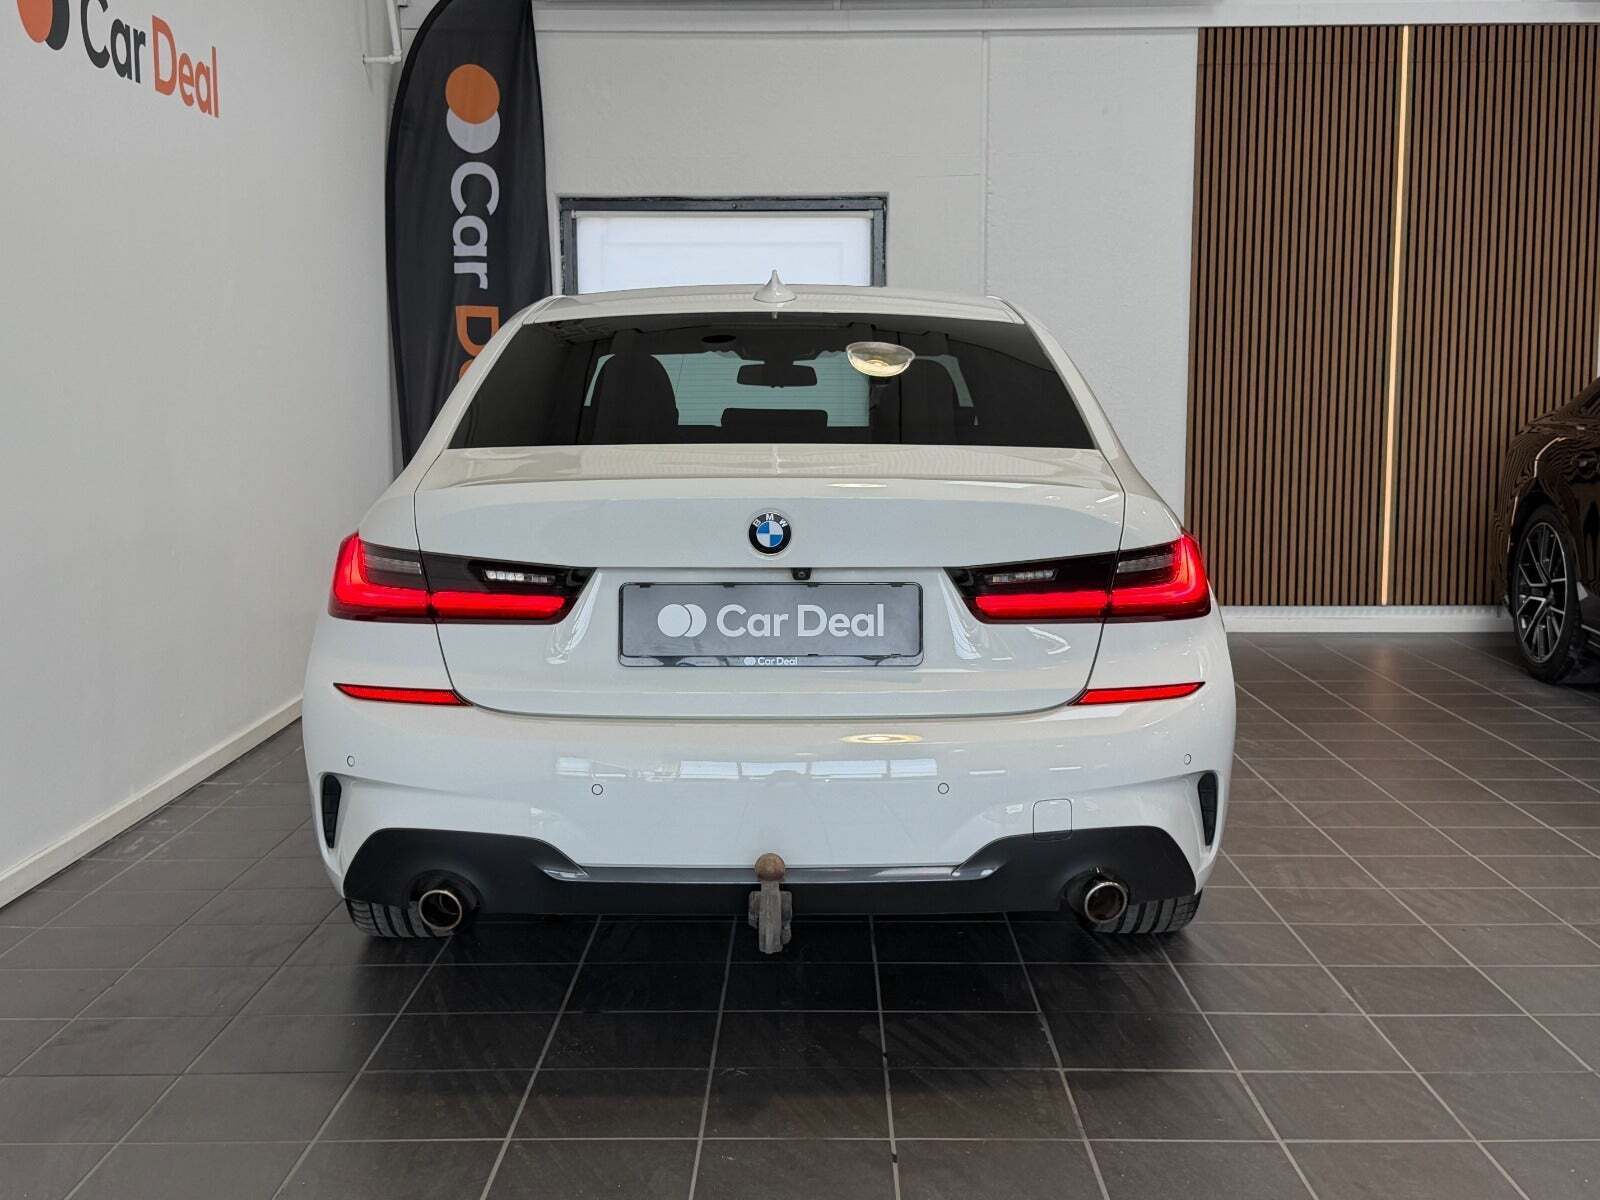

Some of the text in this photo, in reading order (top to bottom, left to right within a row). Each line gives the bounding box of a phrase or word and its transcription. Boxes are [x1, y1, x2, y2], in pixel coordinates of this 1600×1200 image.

[80, 0, 219, 118] Car Deal
[450, 161, 499, 379] Car D
[752, 513, 788, 528] BMW
[716, 603, 884, 637] Car Deal
[757, 656, 798, 666] Car Deal
